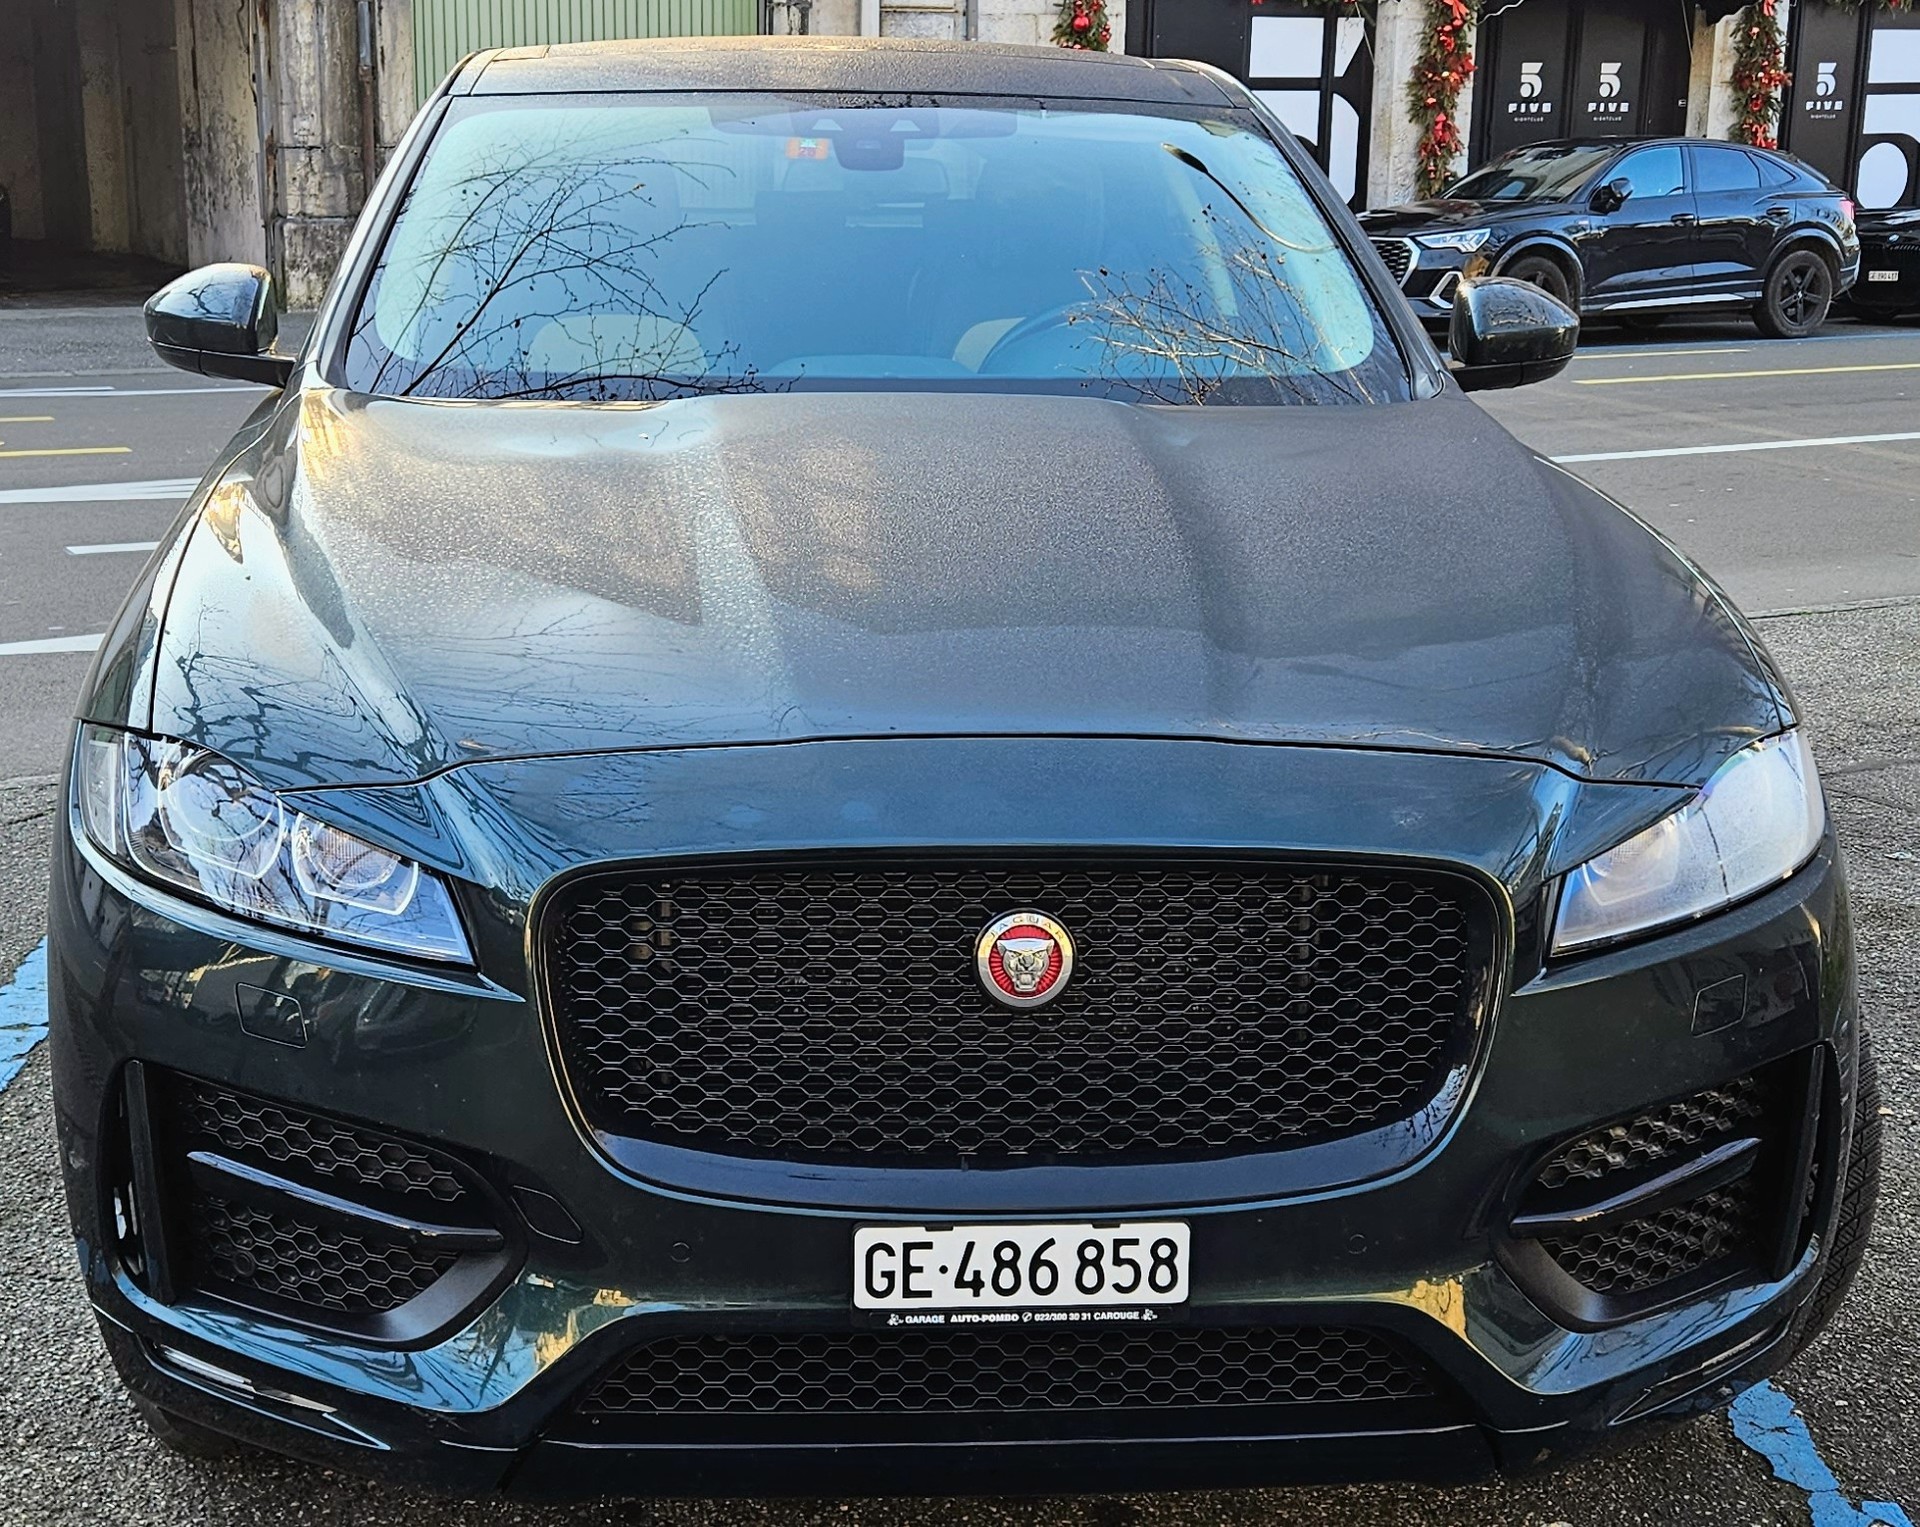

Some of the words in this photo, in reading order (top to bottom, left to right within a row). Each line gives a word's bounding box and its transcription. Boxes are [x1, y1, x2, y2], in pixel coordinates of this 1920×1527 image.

[1520, 62, 1543, 98] 5
[1599, 62, 1622, 98] 5
[1816, 62, 1837, 97] 5
[1508, 102, 1552, 113] FIVE
[1587, 102, 1629, 113] FIVE
[1805, 100, 1843, 111] FIVE
[1075, 1237, 1179, 1295] 858
[904, 1314, 945, 1324] GARAGE
[950, 1313, 1020, 1323] AUTO-POMBO
[1081, 1311, 1091, 1321] 31
[1093, 1311, 1140, 1320] CAROUGE
